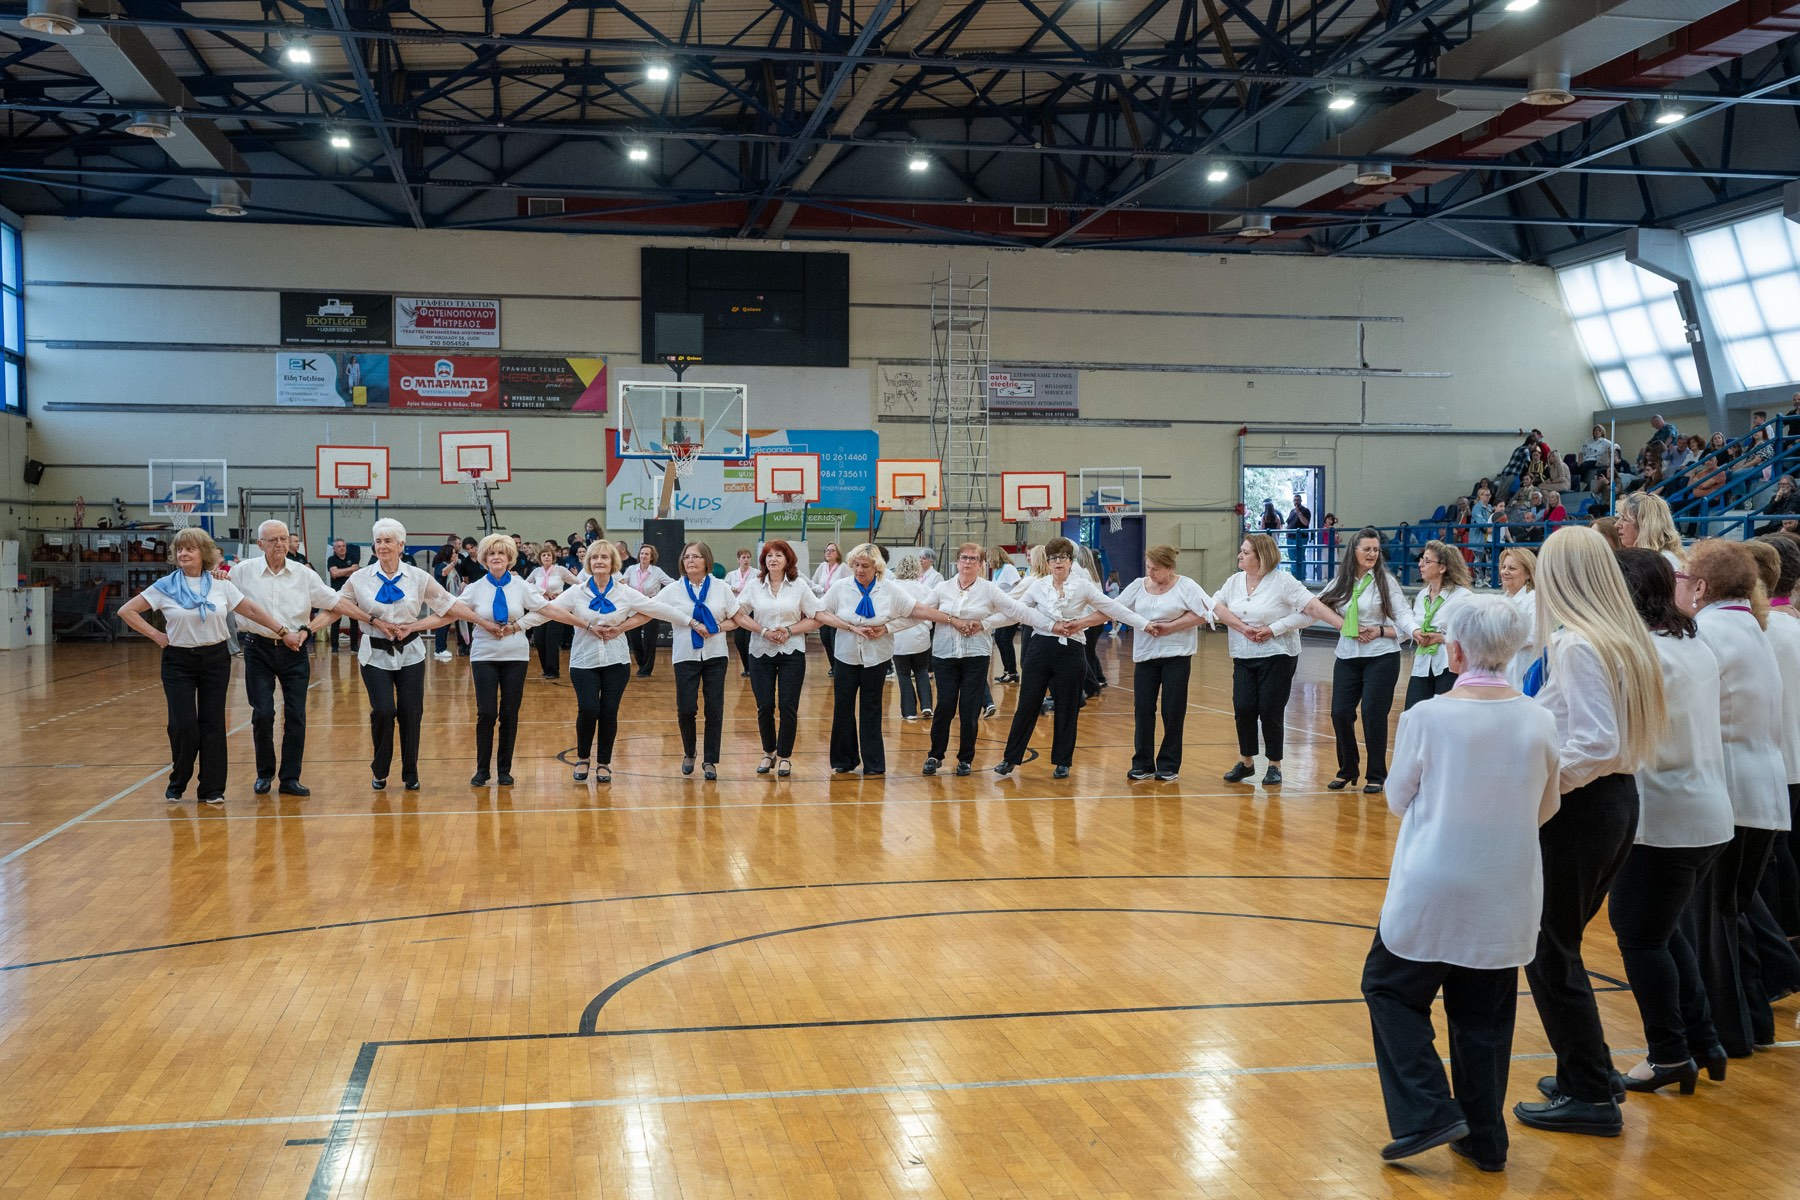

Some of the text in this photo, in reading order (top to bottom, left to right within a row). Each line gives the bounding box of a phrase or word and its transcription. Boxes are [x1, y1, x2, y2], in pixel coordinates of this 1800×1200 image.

[420, 308, 494, 318] ΦΩΤΕΙΝΟΠΟΥΛΟΥ
[306, 317, 366, 326] BOOTLEGGER
[433, 318, 480, 328] ΜΗΤΡΕΛΟΣ
[415, 379, 485, 389] ΜΠΑΡΜΠΑΣ
[675, 493, 722, 511] KIDS
